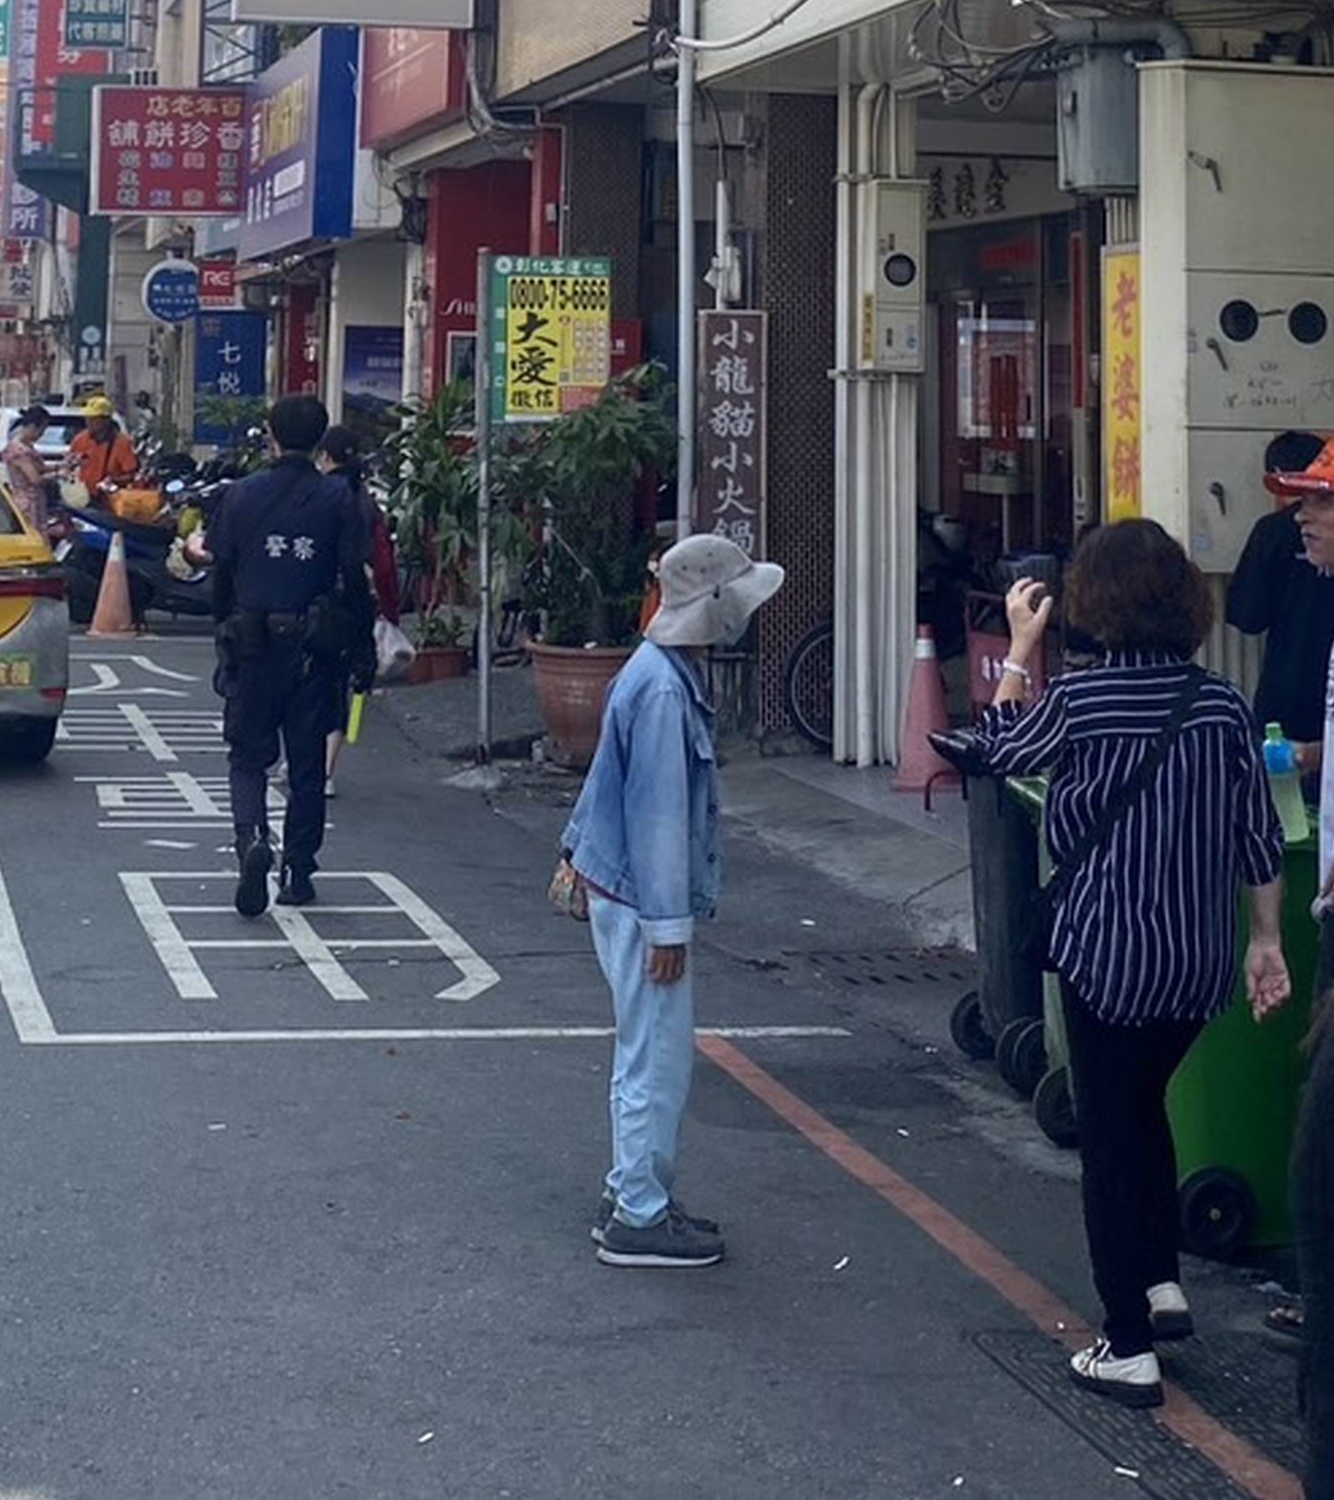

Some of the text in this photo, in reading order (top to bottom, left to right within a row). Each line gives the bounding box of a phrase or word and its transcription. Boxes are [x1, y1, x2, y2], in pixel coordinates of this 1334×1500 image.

[510, 278, 607, 311] 0800-75-6666
[511, 310, 559, 386] 大愛
[708, 319, 755, 555] 小龍貓小火鍋
[265, 533, 317, 560] 警察
